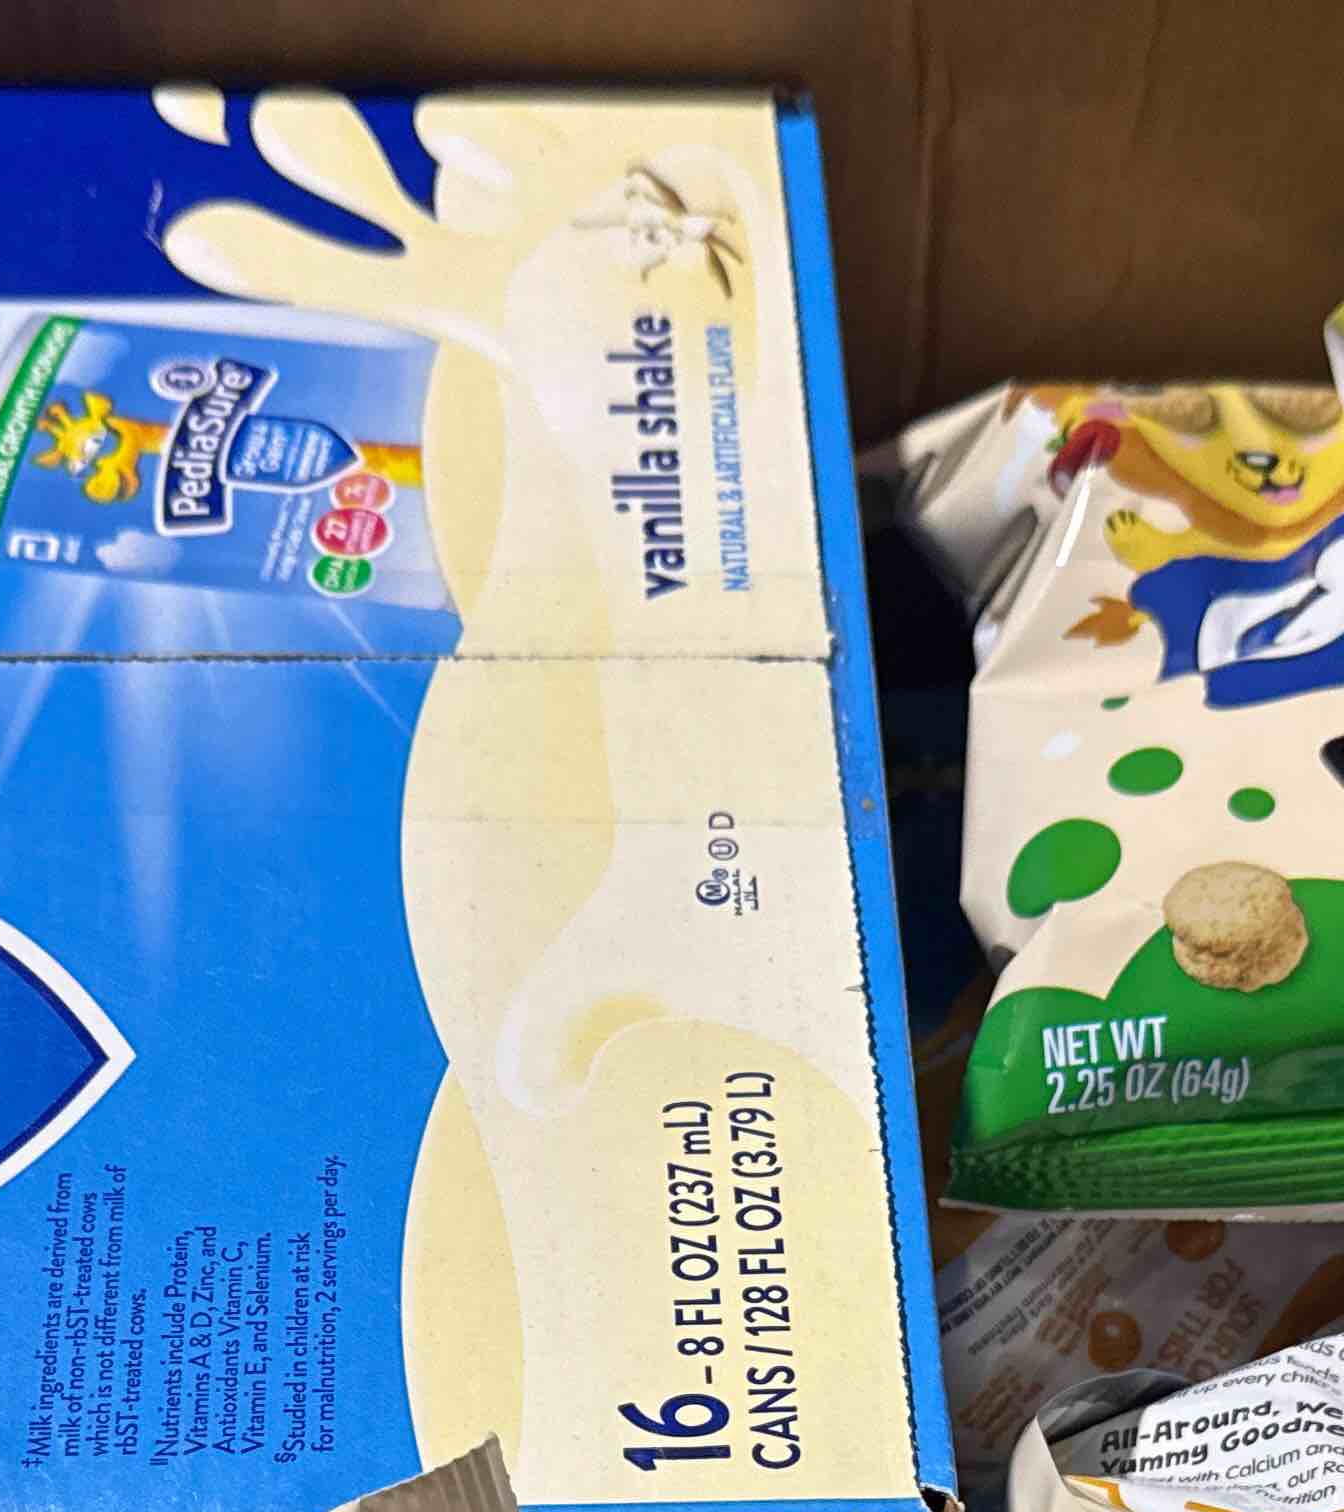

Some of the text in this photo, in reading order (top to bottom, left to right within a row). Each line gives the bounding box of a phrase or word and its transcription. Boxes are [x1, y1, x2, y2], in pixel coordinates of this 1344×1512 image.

[705, 324, 736, 387] FLAVOR
[170, 362, 254, 517] PediaSure
[606, 313, 688, 600] vanilla shake
[710, 387, 742, 479] ARTIFICIAL
[716, 503, 751, 592] NATURAL
[1042, 1014, 1169, 1069] NET WT
[725, 1071, 775, 1098] L)
[1046, 1057, 1250, 1114] 2.25 OZ (64g)
[662, 1101, 713, 1155] mL)
[729, 1107, 783, 1178] (3.79
[47, 1172, 72, 1212] from
[82, 1192, 97, 1232] cows
[667, 1162, 720, 1226] (237
[733, 1186, 782, 1231] OZ
[42, 1217, 67, 1277] derived
[670, 1234, 719, 1281] OZ
[738, 1238, 786, 1275] FL
[48, 1282, 63, 1308] are
[674, 1288, 723, 1326] FL
[742, 1284, 791, 1336] 128
[31, 1312, 64, 1410] ingredients
[677, 1336, 725, 1355] 8
[61, 1393, 82, 1413] of
[746, 1365, 801, 1469] CANS
[1101, 1400, 1280, 1453] All-Around,
[58, 1416, 81, 1456] milk
[617, 1393, 731, 1471] 16
[1100, 1443, 1209, 1476] Yummy
